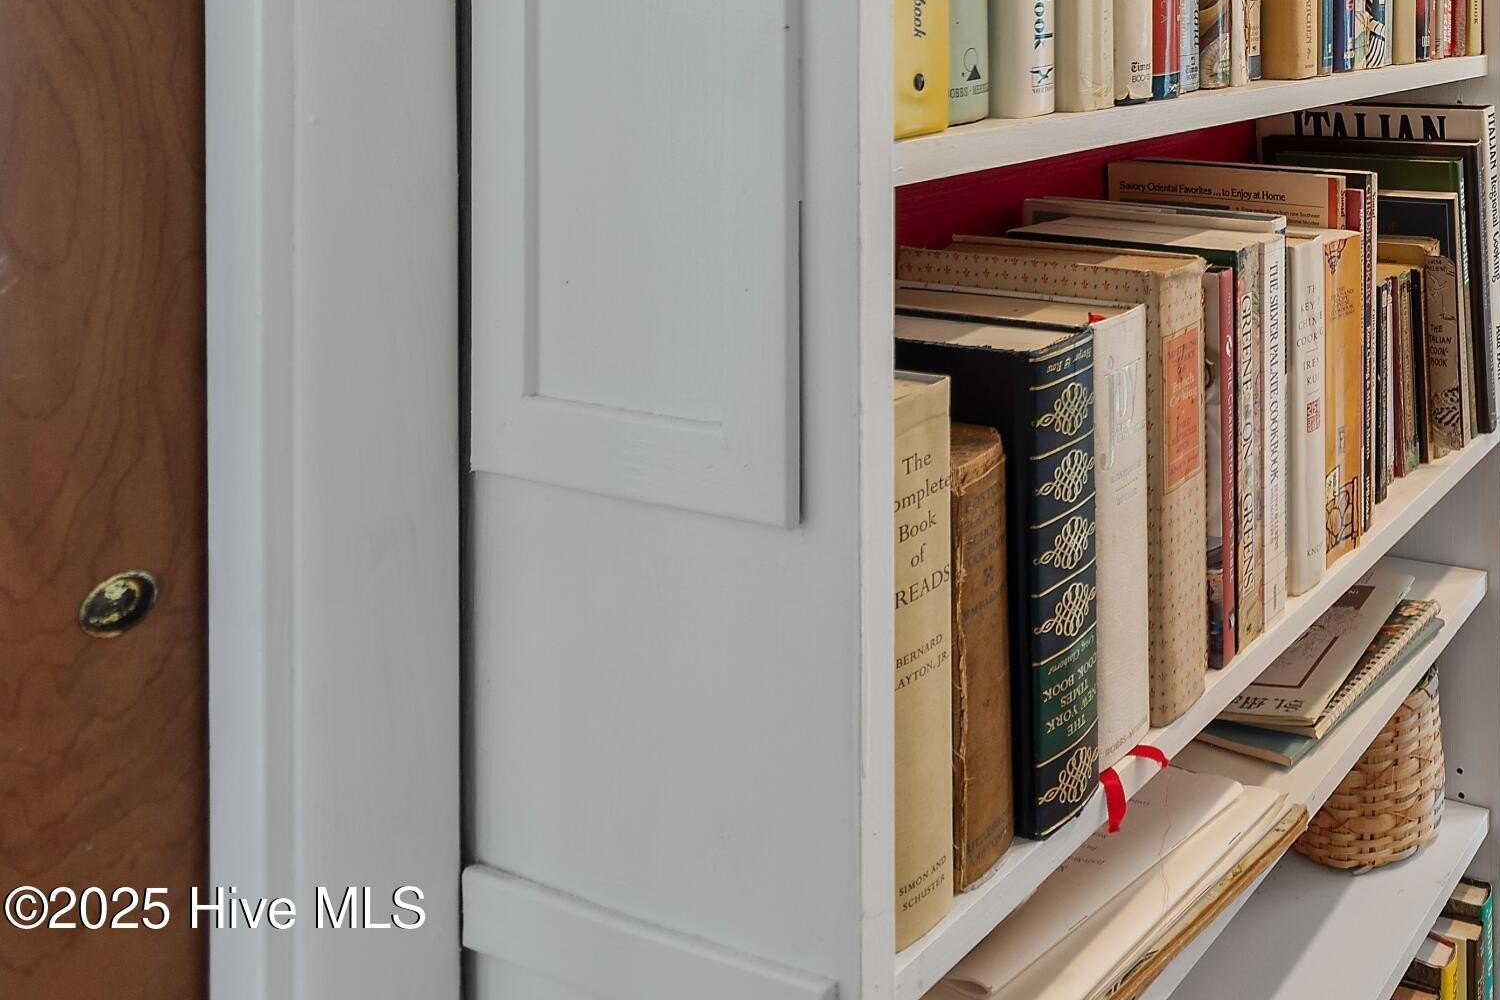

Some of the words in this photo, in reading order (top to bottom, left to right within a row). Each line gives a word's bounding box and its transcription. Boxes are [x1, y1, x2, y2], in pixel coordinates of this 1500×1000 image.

[1292, 110, 1447, 141] ITALIAN
[1487, 112, 1499, 171] ITALIAN
[1119, 182, 1147, 193] Savory
[1147, 183, 1179, 194] Oriental
[1179, 185, 1213, 196] Favorites
[1231, 189, 1252, 200] Enjoy
[1262, 191, 1286, 202] Home
[1489, 174, 1500, 228] Regional
[1269, 261, 1279, 293] THE
[1269, 295, 1279, 342] SILVER
[1430, 324, 1443, 333] THE
[1241, 294, 1254, 392] GREENE
[1269, 344, 1279, 396] PALATE
[1242, 421, 1254, 460] ON
[1269, 399, 1280, 484] COOKBOOK
[901, 451, 933, 476] The
[894, 475, 952, 513] omplete
[898, 511, 937, 544] Book
[1243, 492, 1255, 589] GREENS
[910, 542, 927, 569] of
[895, 633, 944, 670] BERNARD
[895, 658, 937, 691] LAYTON,
[1040, 672, 1075, 704] BOOK
[1060, 678, 1089, 707] TIMES
[1045, 706, 1079, 735] YORK
[1066, 713, 1087, 737] THE
[898, 870, 927, 896] SIMON
[930, 854, 947, 873] AND
[901, 873, 946, 912] SCHUSTER
